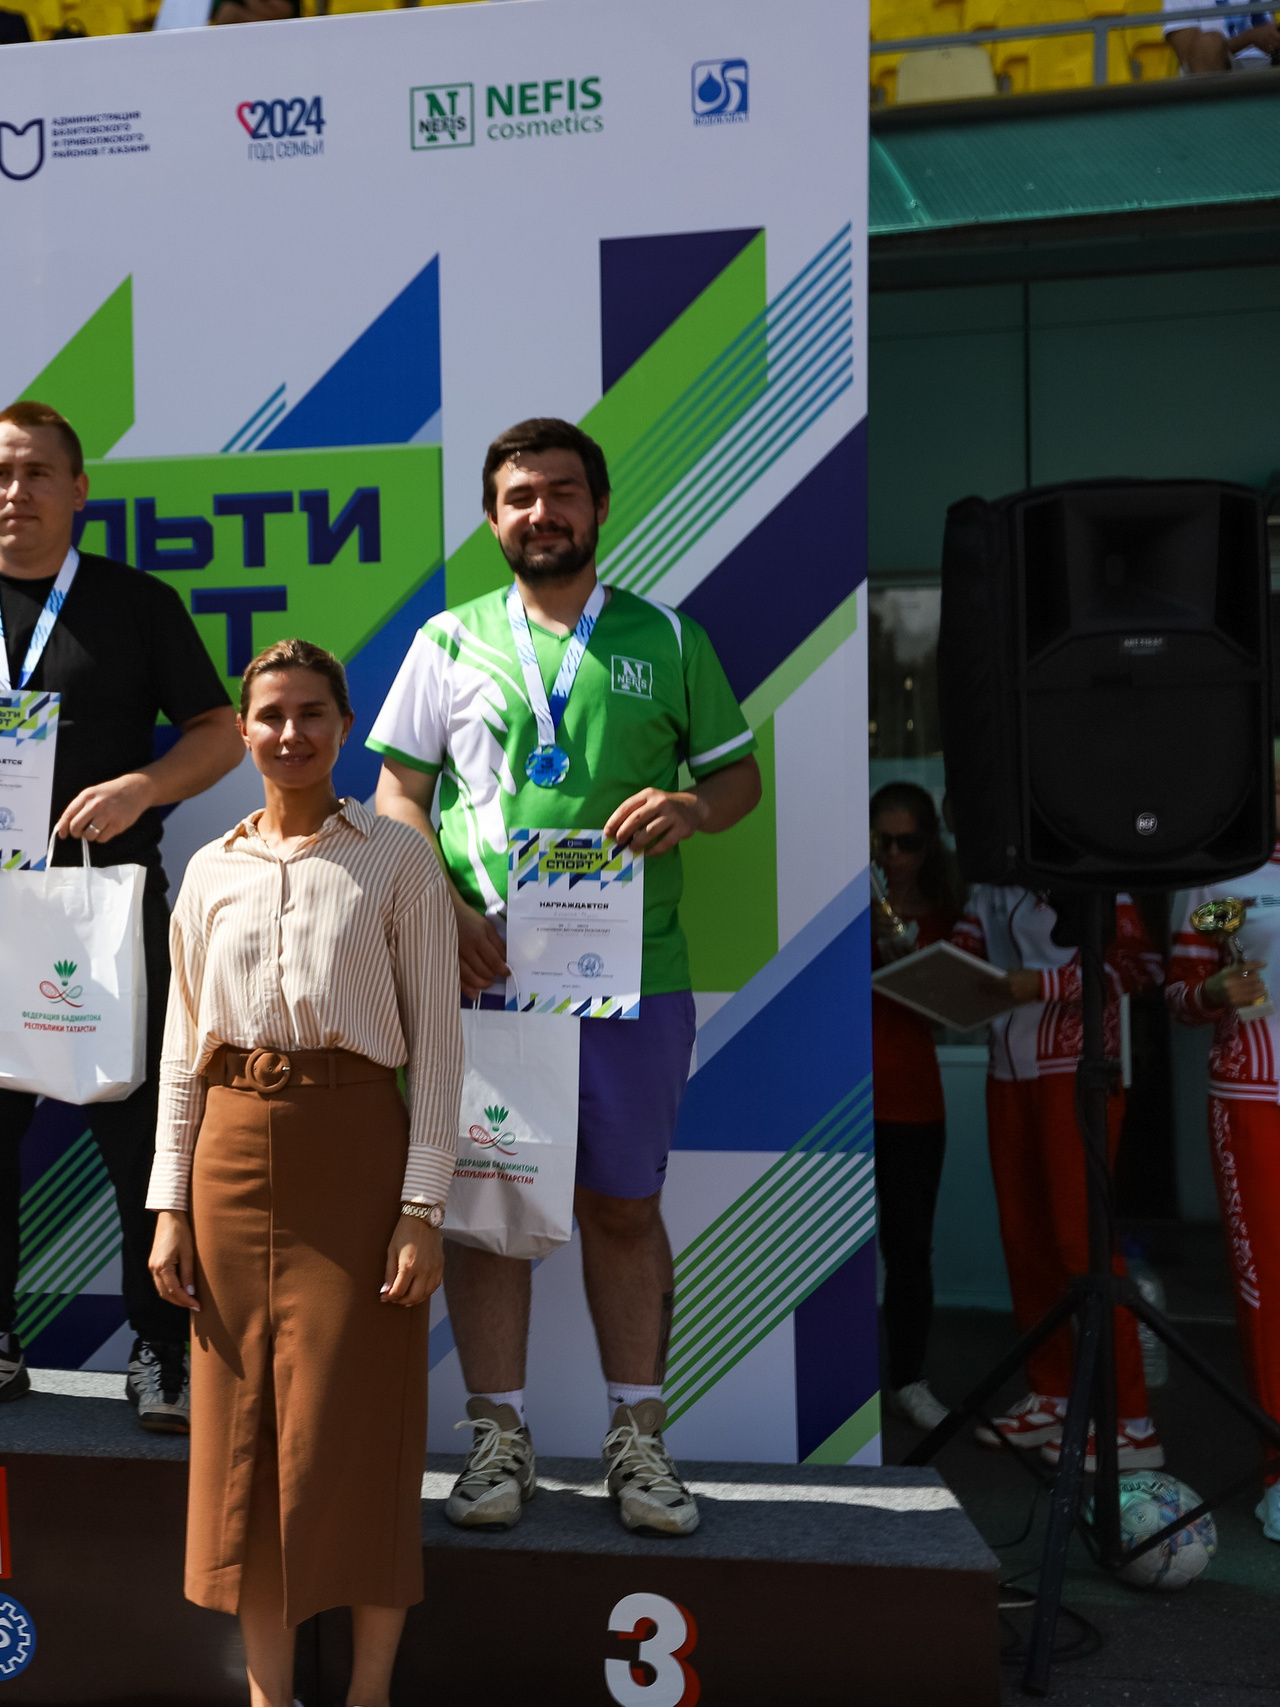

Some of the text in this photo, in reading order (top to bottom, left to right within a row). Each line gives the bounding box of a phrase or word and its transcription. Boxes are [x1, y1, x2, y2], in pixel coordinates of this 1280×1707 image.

[486, 76, 603, 118] NEFIS
[52, 111, 141, 126] АДМИНИСТРАЦИЯ
[250, 96, 326, 139] 2024
[418, 116, 467, 133] NEFIS
[486, 112, 604, 141] cosmetics
[247, 139, 325, 162] ГОД СЕМЬИ
[554, 850, 604, 860] МУЛЬТИ
[546, 859, 594, 870] СПОРТ
[539, 900, 610, 910] НАГРАЖДАЕТСЯ
[22, 1010, 102, 1022] ФЕДЕРАЦИЯ БАДМИНТОНА
[23, 1021, 97, 1033] РЕСПУБЛИКИ ТАТАРСТАН
[455, 1157, 539, 1174] ЕДЕРАЦИЯ БАДМИНТОНА
[496, 1171, 535, 1185] ТАТАРСТАН
[603, 1592, 701, 1706] 3
